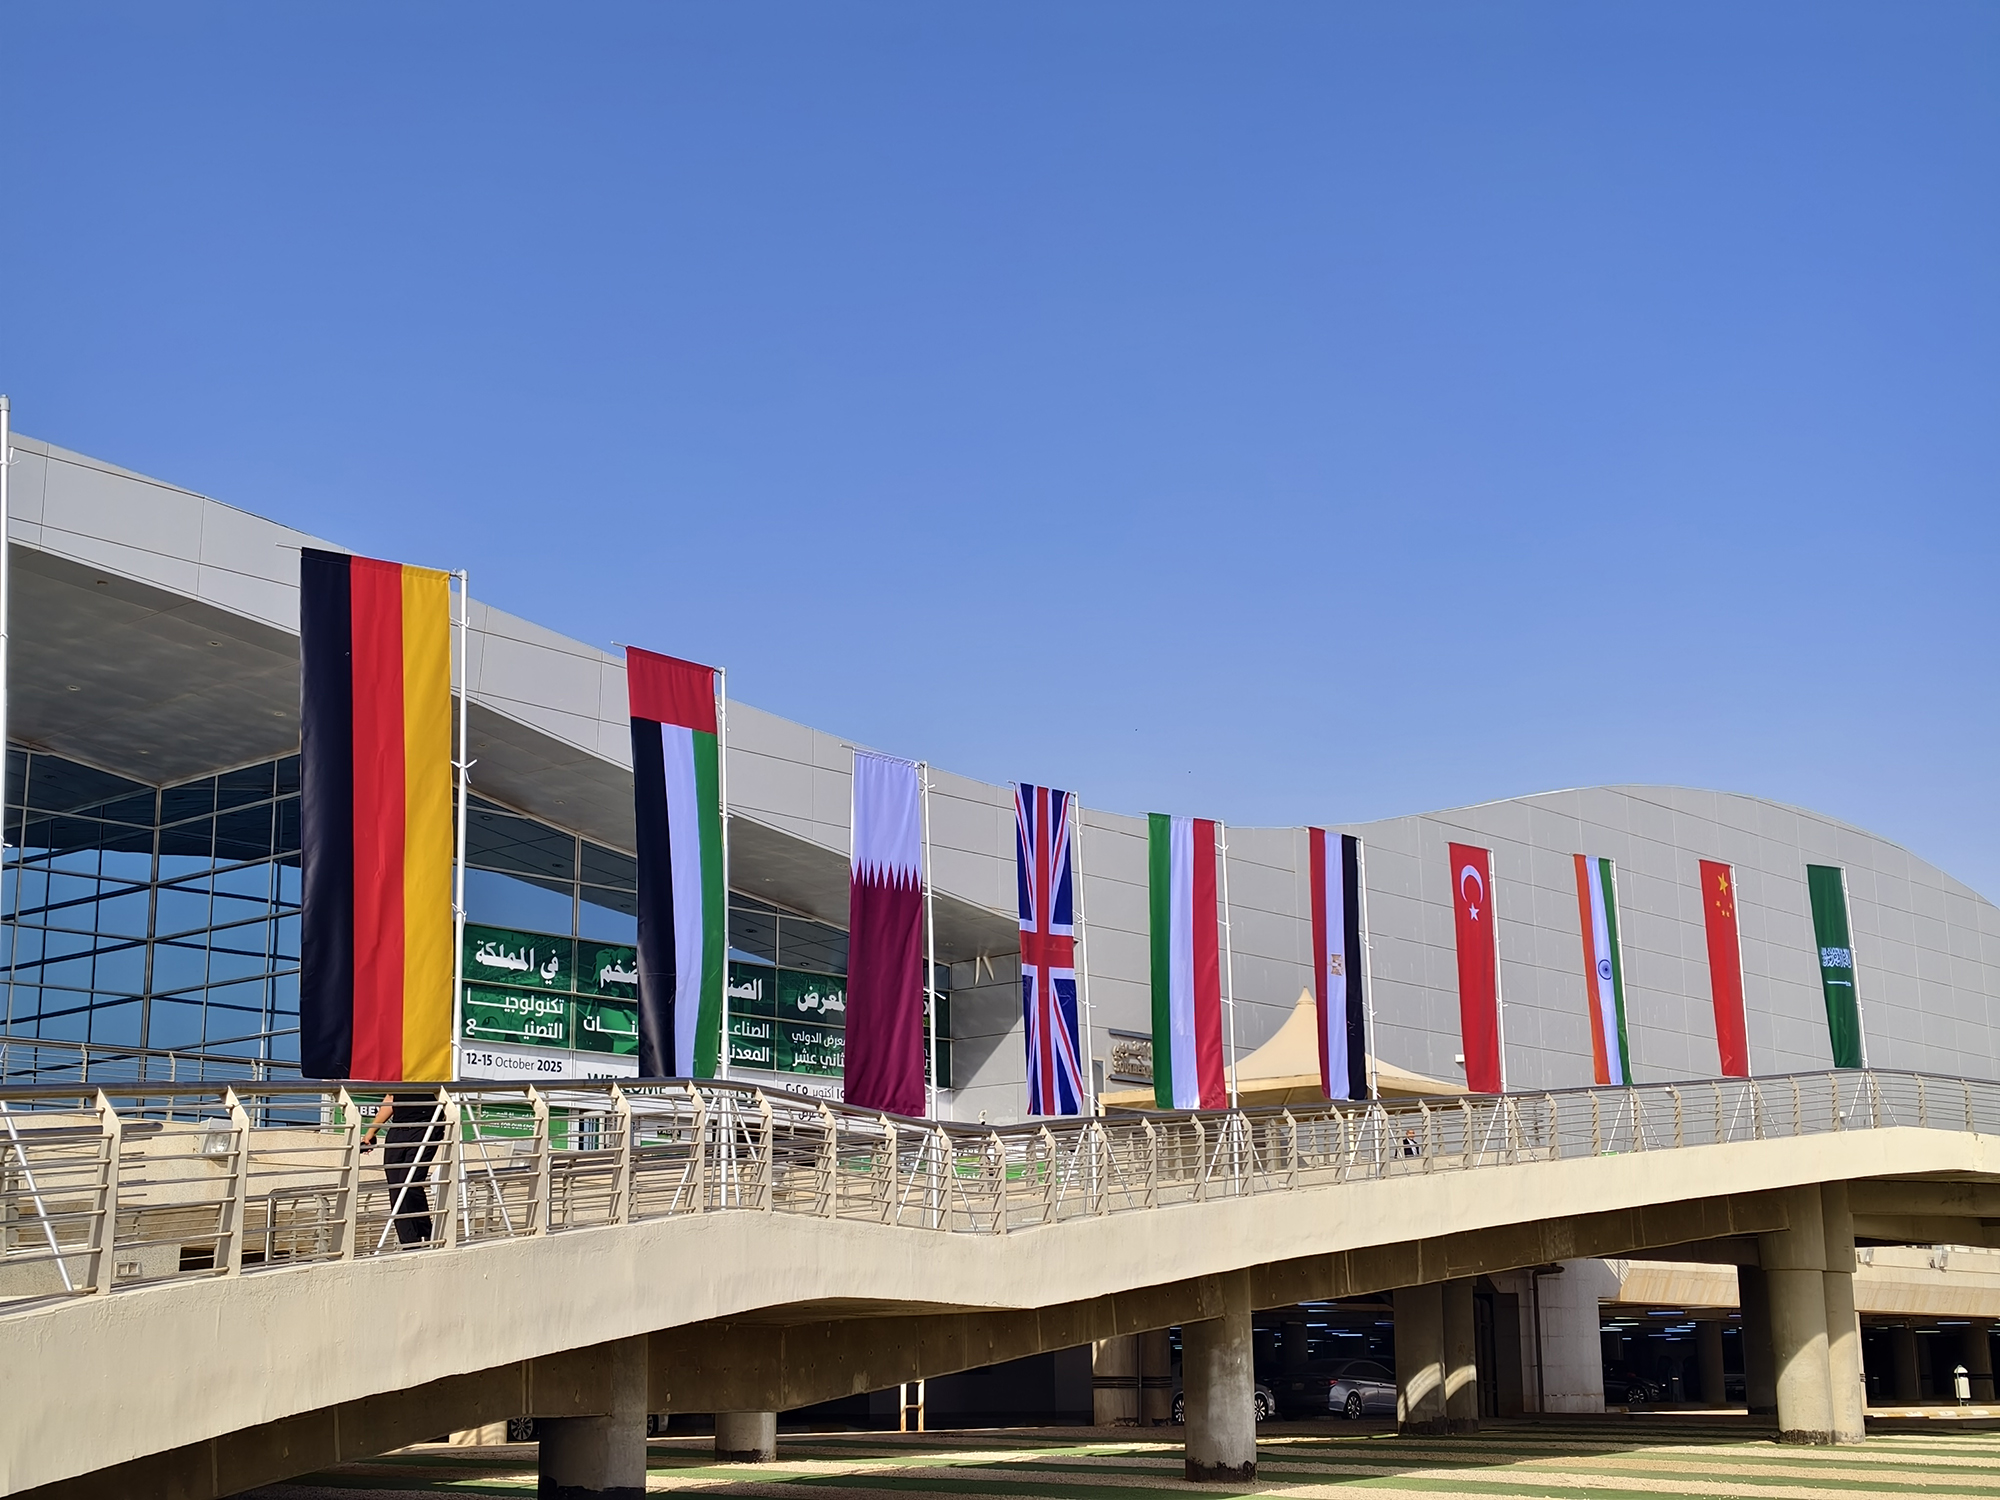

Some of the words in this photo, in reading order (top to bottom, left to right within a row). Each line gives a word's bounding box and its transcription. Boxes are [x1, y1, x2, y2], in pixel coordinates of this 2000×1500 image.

[475, 939, 535, 972] المملكة
[540, 949, 559, 985] في
[797, 985, 847, 1015] لمعرض
[791, 1030, 822, 1046] الدولي
[466, 1052, 493, 1067] 12-15
[495, 1056, 535, 1071] October
[537, 1059, 563, 1074] 2025
[792, 1048, 817, 1067] عشر
